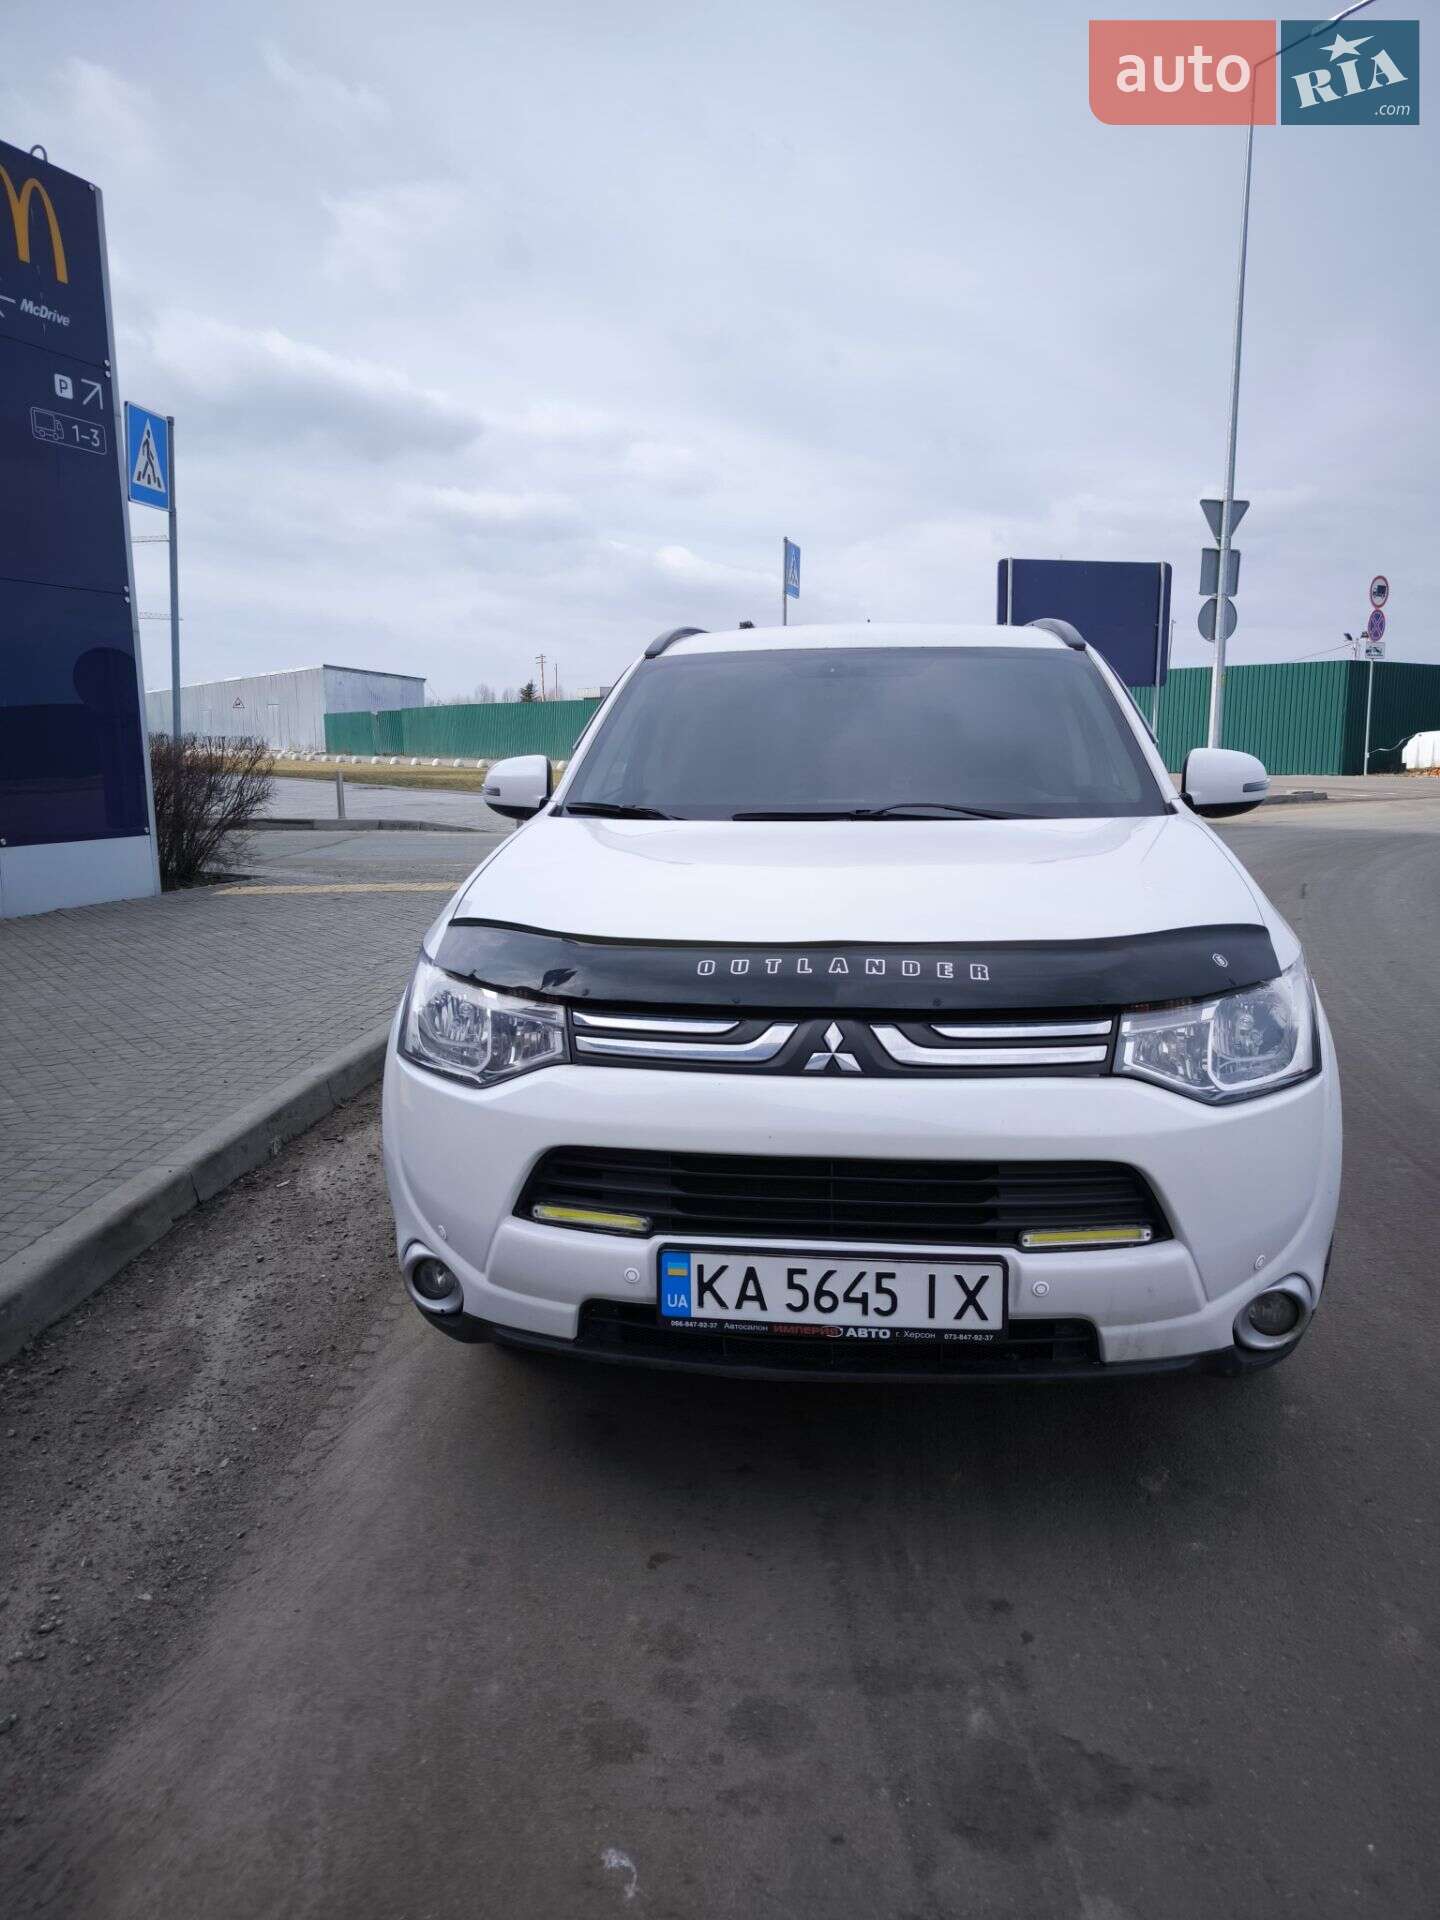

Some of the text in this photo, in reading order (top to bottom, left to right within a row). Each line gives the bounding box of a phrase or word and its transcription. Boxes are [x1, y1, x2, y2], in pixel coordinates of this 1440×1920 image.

[20, 298, 70, 326] McDrive
[72, 424, 100, 447] 1-3
[697, 957, 989, 980] OUTLANDER
[667, 1293, 688, 1309] UA
[697, 1264, 989, 1321] KA 5645 IX
[724, 1322, 768, 1332] Автосалон
[845, 1327, 891, 1339] АВТО
[903, 1330, 936, 1340] Херсон
